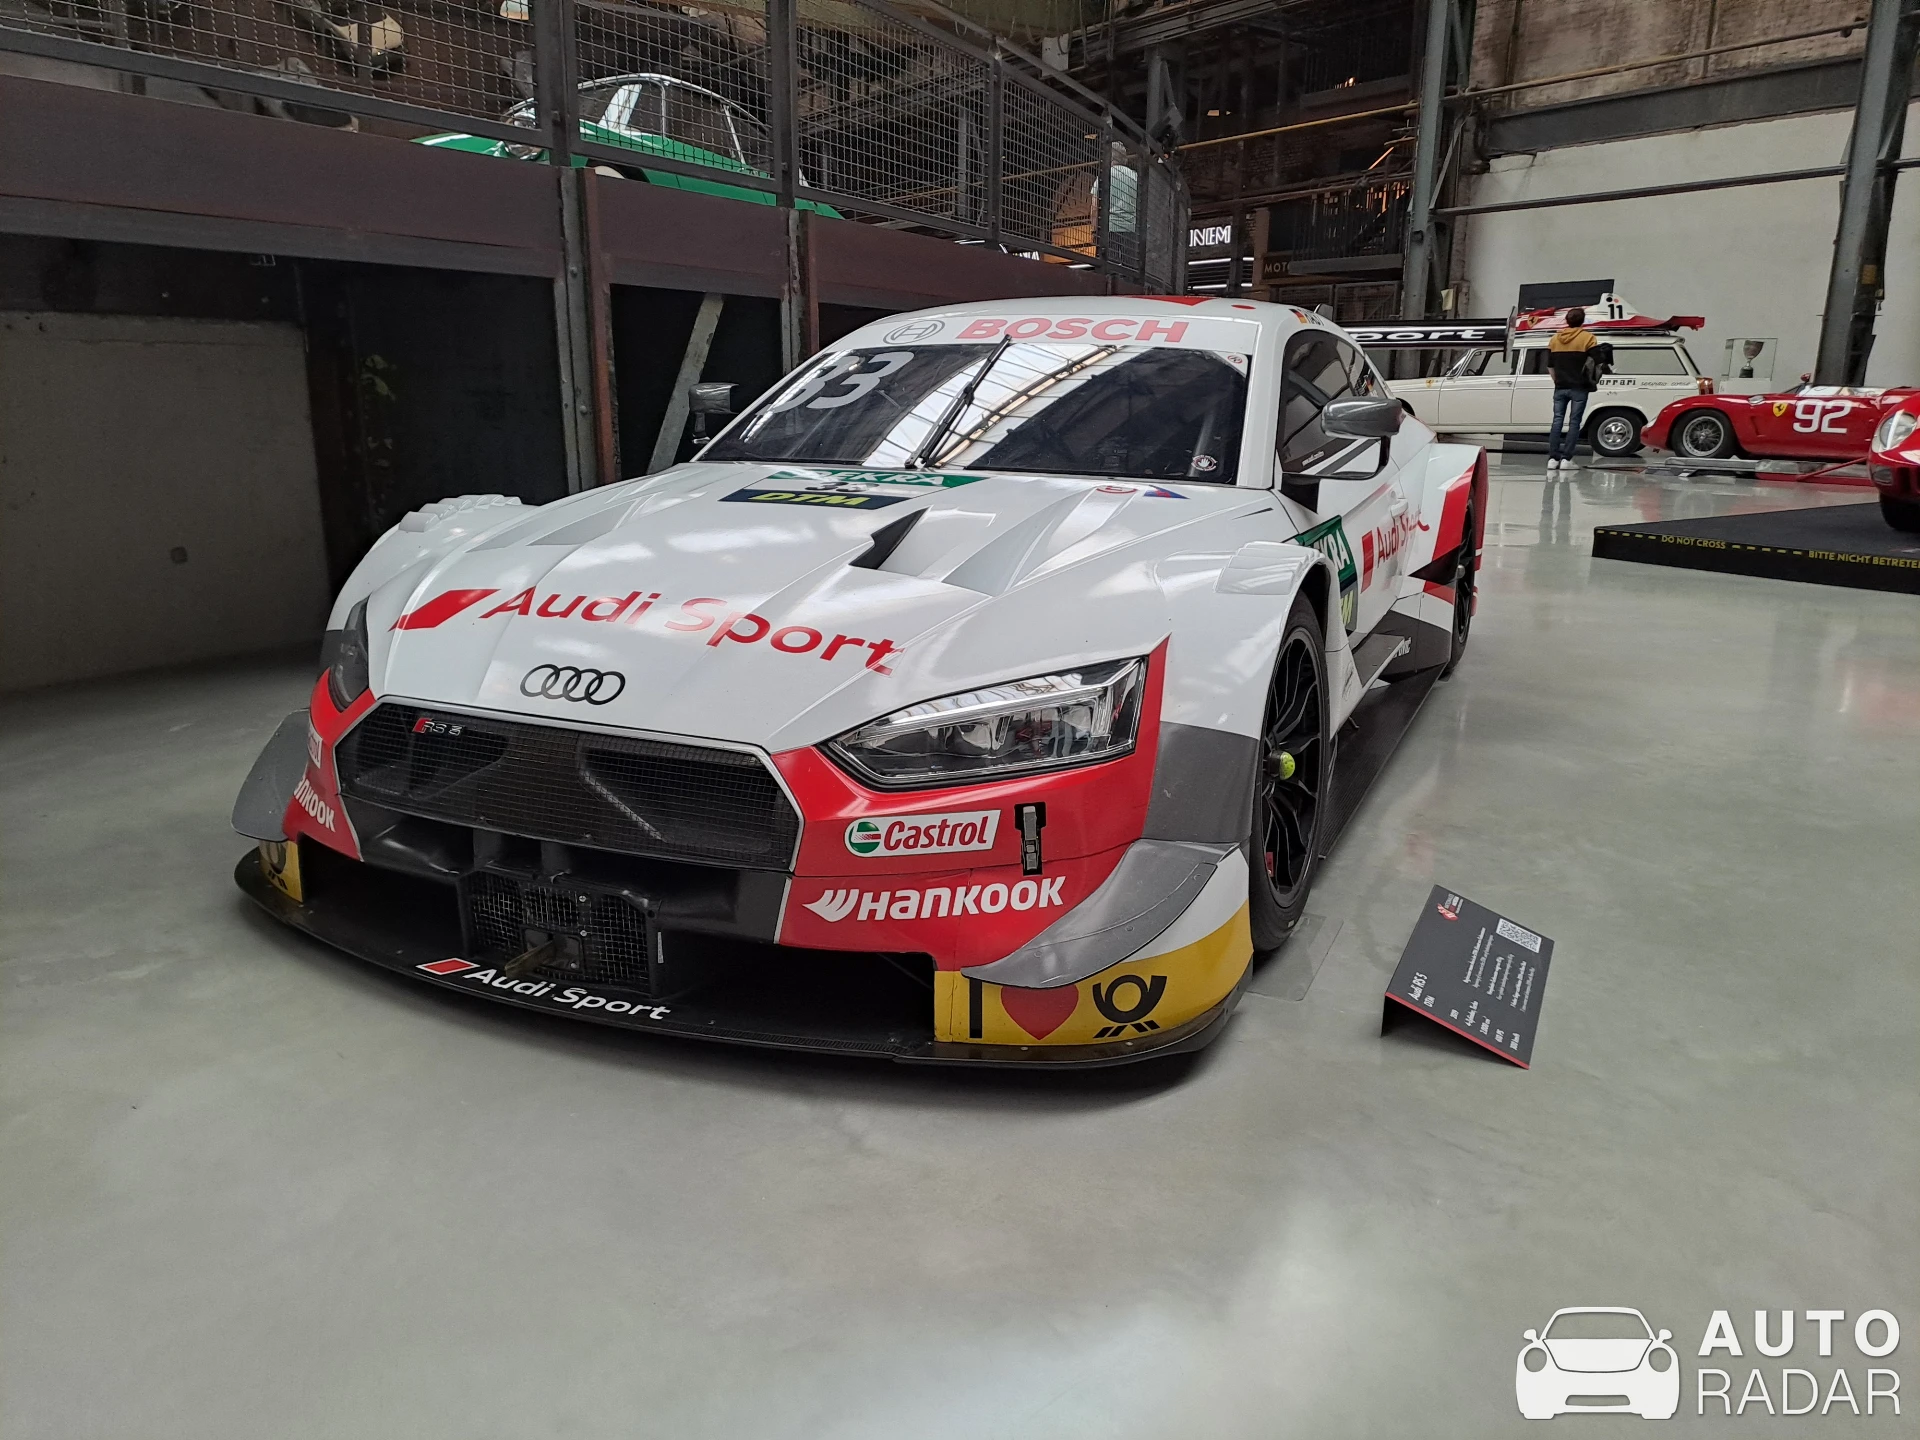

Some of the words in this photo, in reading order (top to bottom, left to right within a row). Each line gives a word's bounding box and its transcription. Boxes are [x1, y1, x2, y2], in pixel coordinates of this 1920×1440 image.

[1264, 261, 1290, 273] MOT
[1608, 303, 1623, 319] 11
[955, 317, 1190, 342] BOSCH
[1792, 398, 1852, 434] 92
[748, 492, 871, 505] DTM
[1661, 535, 1675, 543] DO
[1676, 536, 1696, 545] NOT
[1696, 539, 1726, 549] CROSS
[1808, 550, 1836, 560] BITTE
[1837, 553, 1871, 564] NICHT
[1872, 556, 1920, 569] BETRETE
[479, 585, 661, 624] Audi
[664, 597, 905, 675] Sport
[883, 815, 989, 851] Castrol
[463, 968, 557, 997] Audi
[553, 987, 672, 1020] Sport
